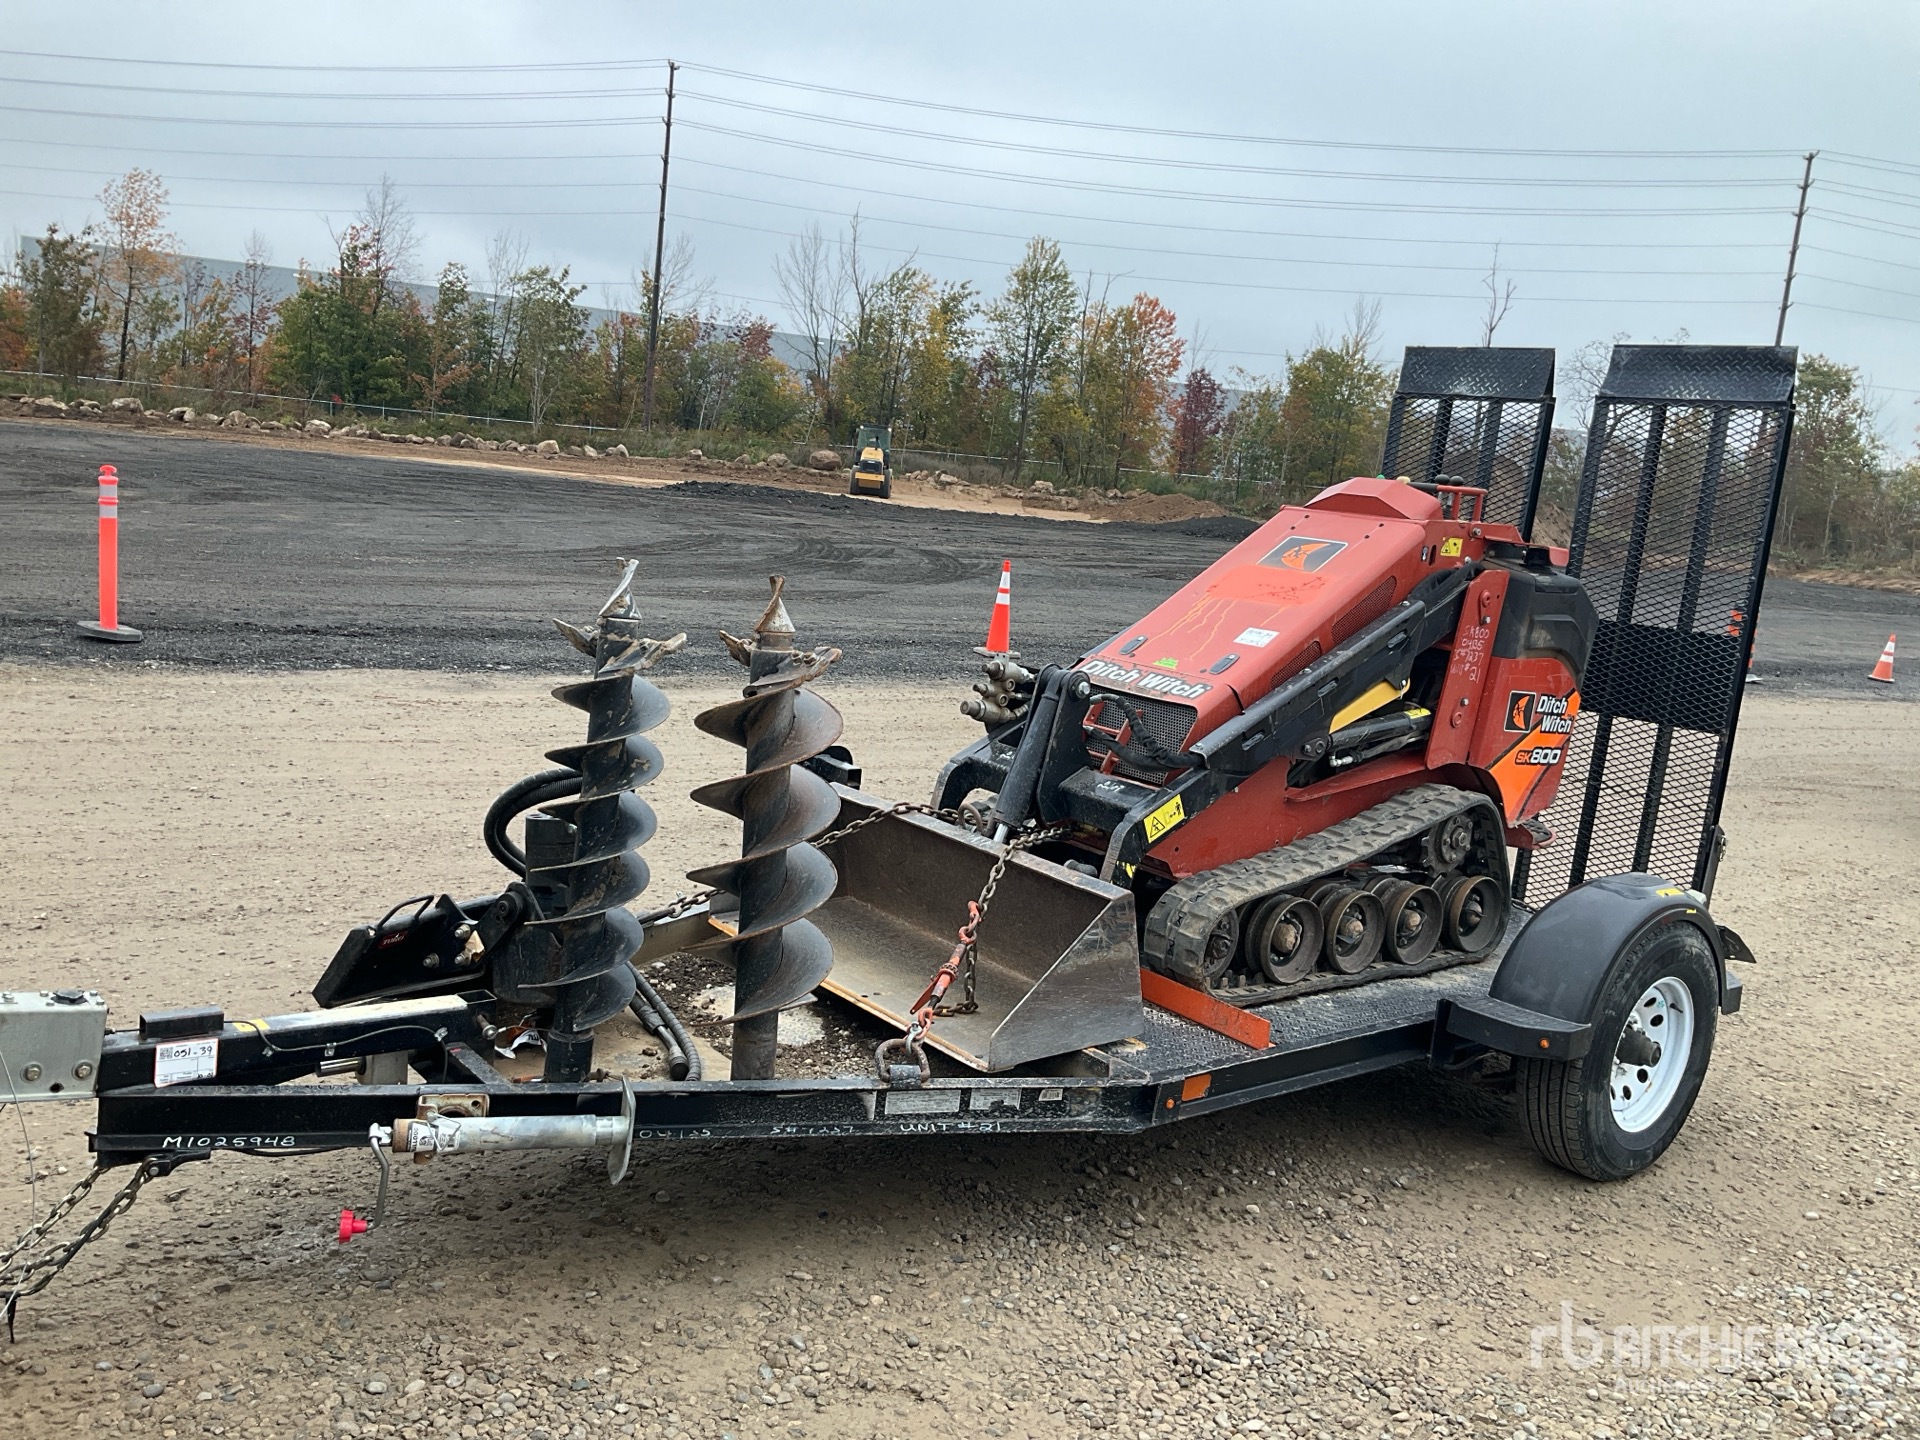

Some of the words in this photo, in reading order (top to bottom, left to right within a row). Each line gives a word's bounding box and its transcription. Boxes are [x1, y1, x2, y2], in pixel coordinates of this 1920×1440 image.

[1080, 659, 1141, 684] Ditch
[1139, 674, 1213, 699] Witch
[1536, 695, 1568, 714] Ditch
[1540, 715, 1572, 733] Witch
[1515, 748, 1561, 764] SK800
[900, 1124, 952, 1132] UNIT
